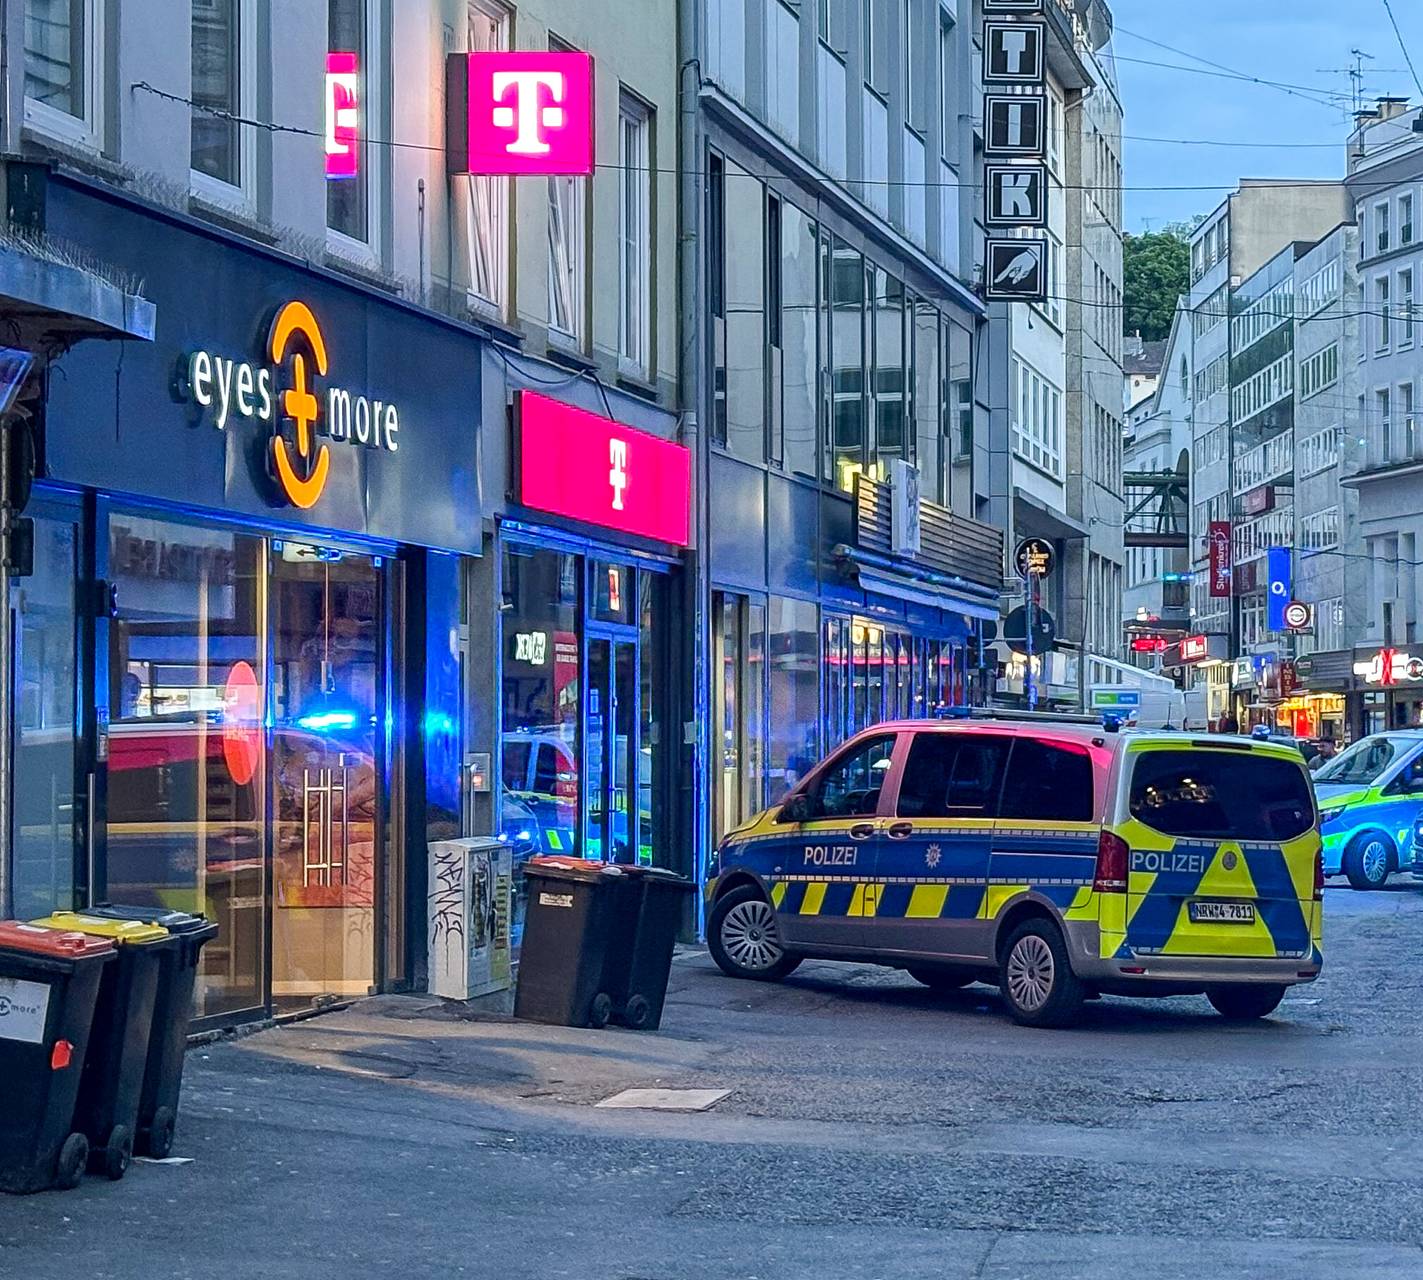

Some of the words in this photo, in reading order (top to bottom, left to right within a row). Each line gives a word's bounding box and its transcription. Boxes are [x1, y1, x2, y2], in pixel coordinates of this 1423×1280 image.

[492, 71, 563, 153] T
[193, 350, 272, 430] eyes
[329, 387, 400, 452] more
[609, 437, 627, 511] T
[803, 846, 858, 866] POLIZEI
[1131, 852, 1206, 873] POLIZEI
